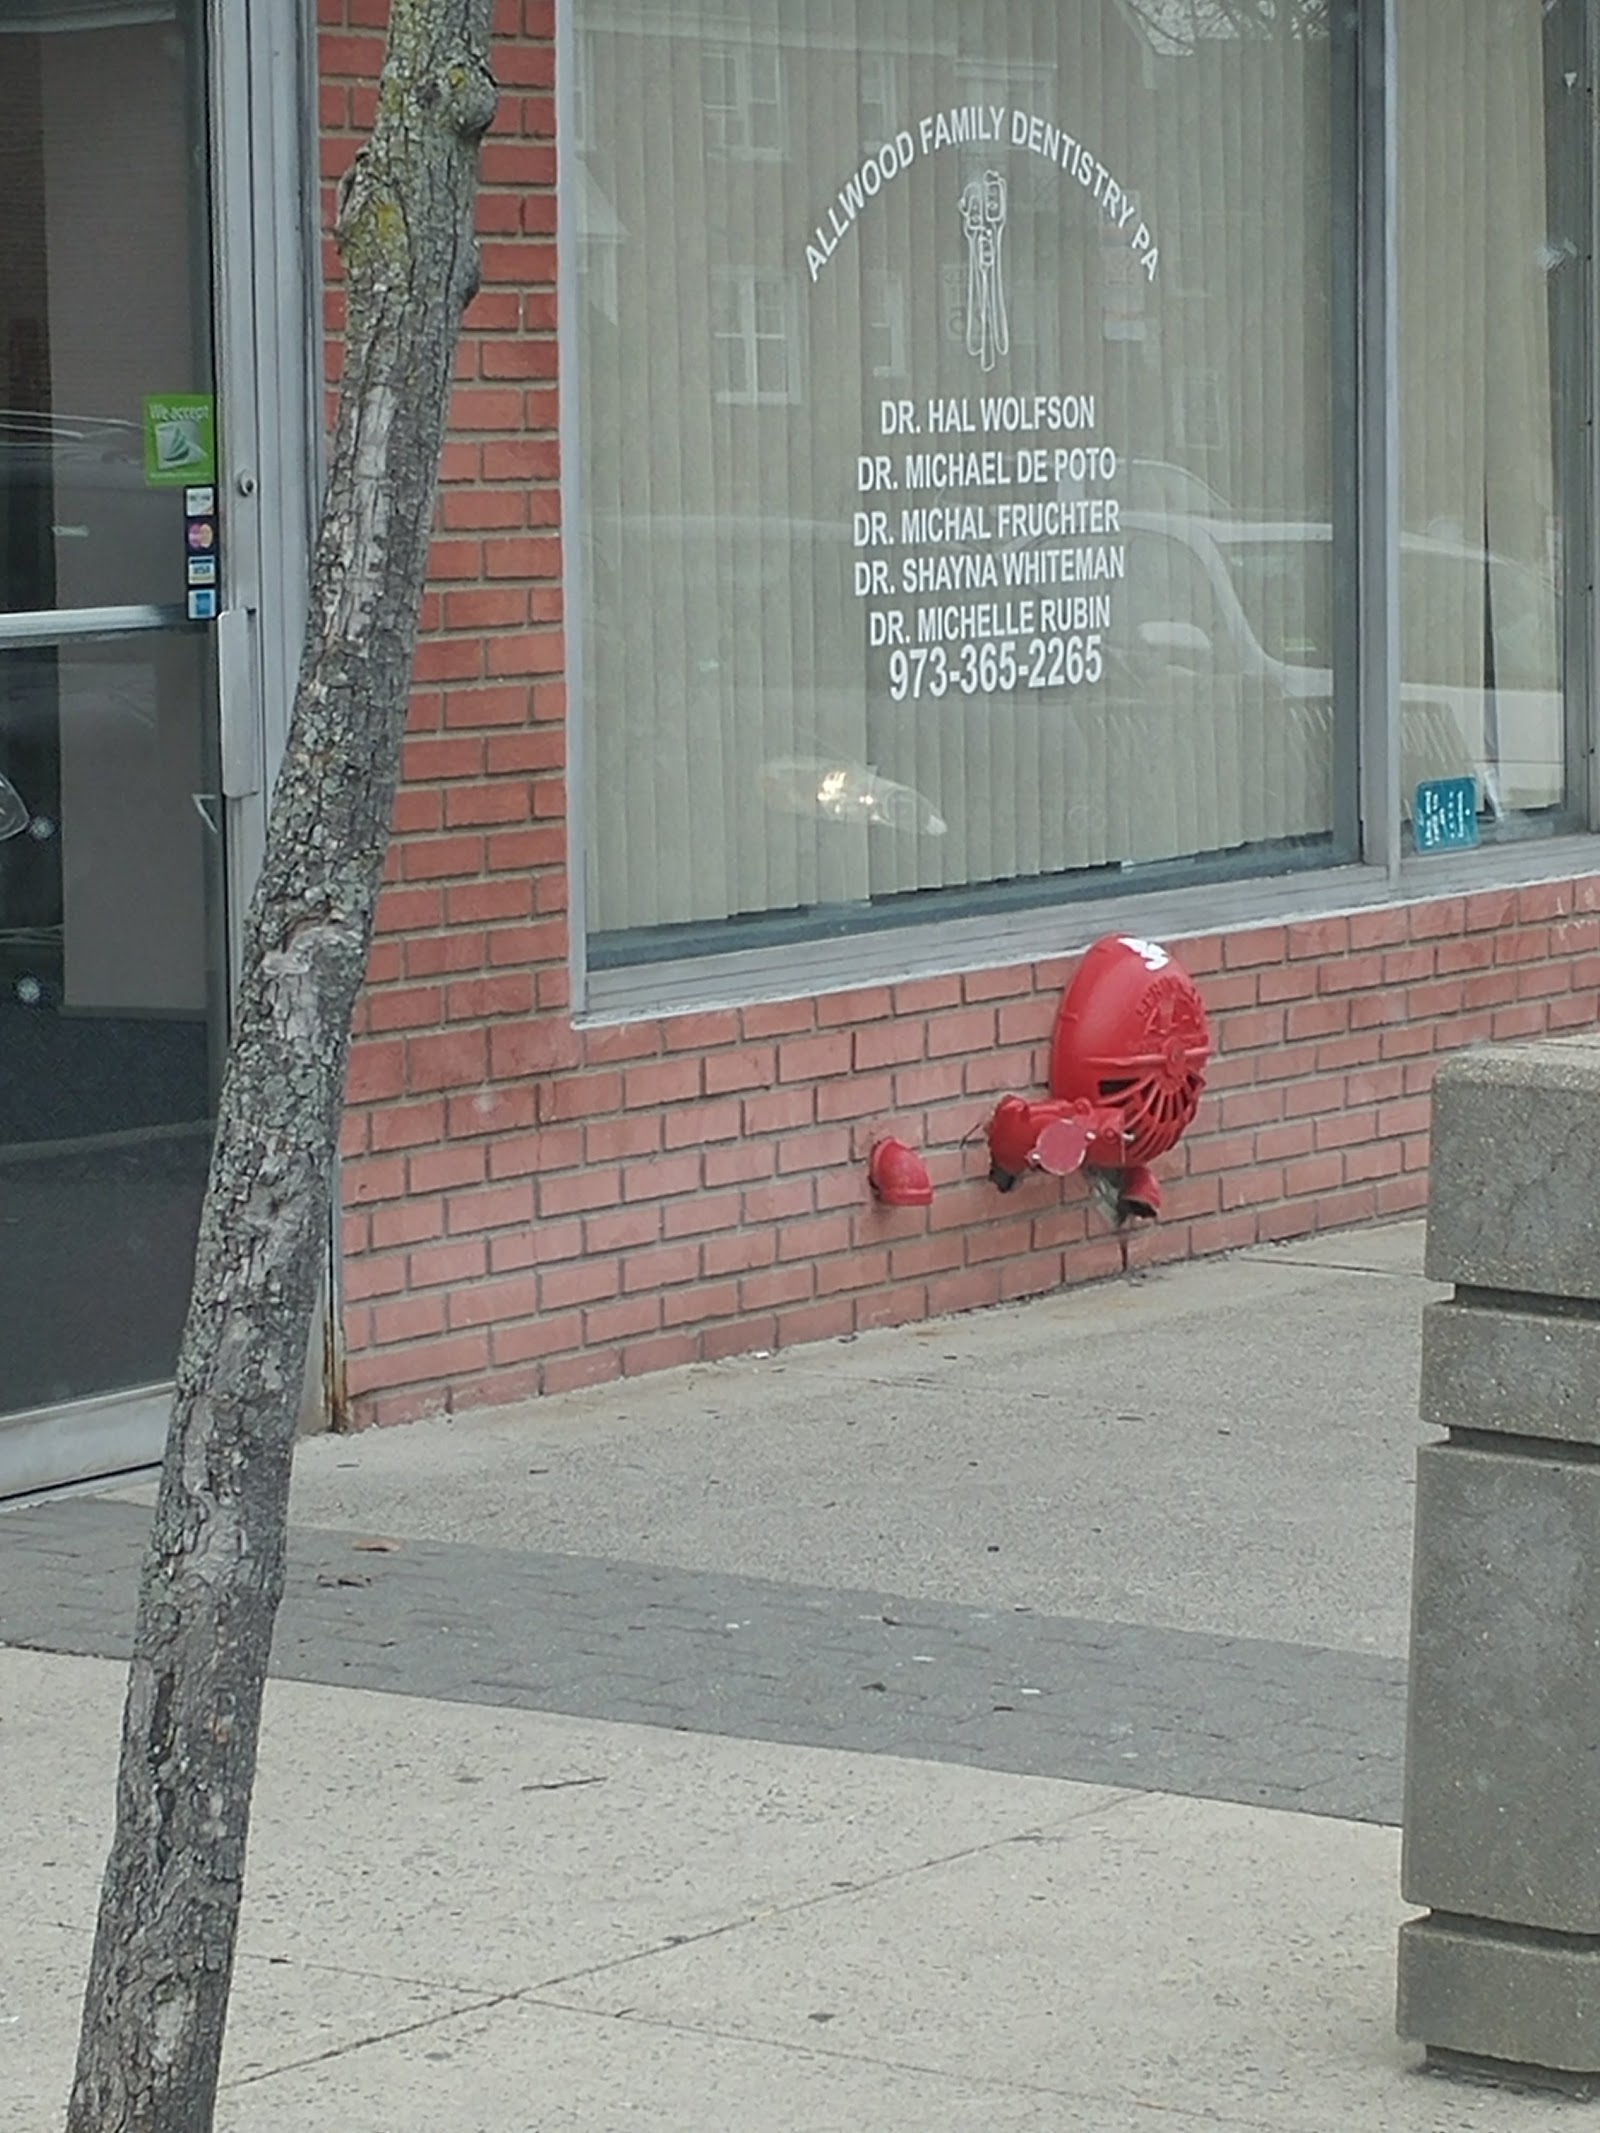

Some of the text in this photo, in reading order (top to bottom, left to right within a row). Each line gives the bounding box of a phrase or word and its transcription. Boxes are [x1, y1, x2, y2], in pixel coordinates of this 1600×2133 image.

[804, 106, 1159, 282] ALLWOOD FAMILY DENTISTRY PA
[881, 395, 1095, 435] DR. HAL WOLFSON
[858, 447, 1116, 491] DR. MICHAEL DE POTO
[854, 499, 1121, 547] DR. MICHAL FRUCHTER
[855, 546, 1125, 596] DR. SHAYNA WHITEMAN
[870, 595, 1110, 646] DR. MICHELLE RUBIN
[889, 634, 1102, 701] 973-365-2265
